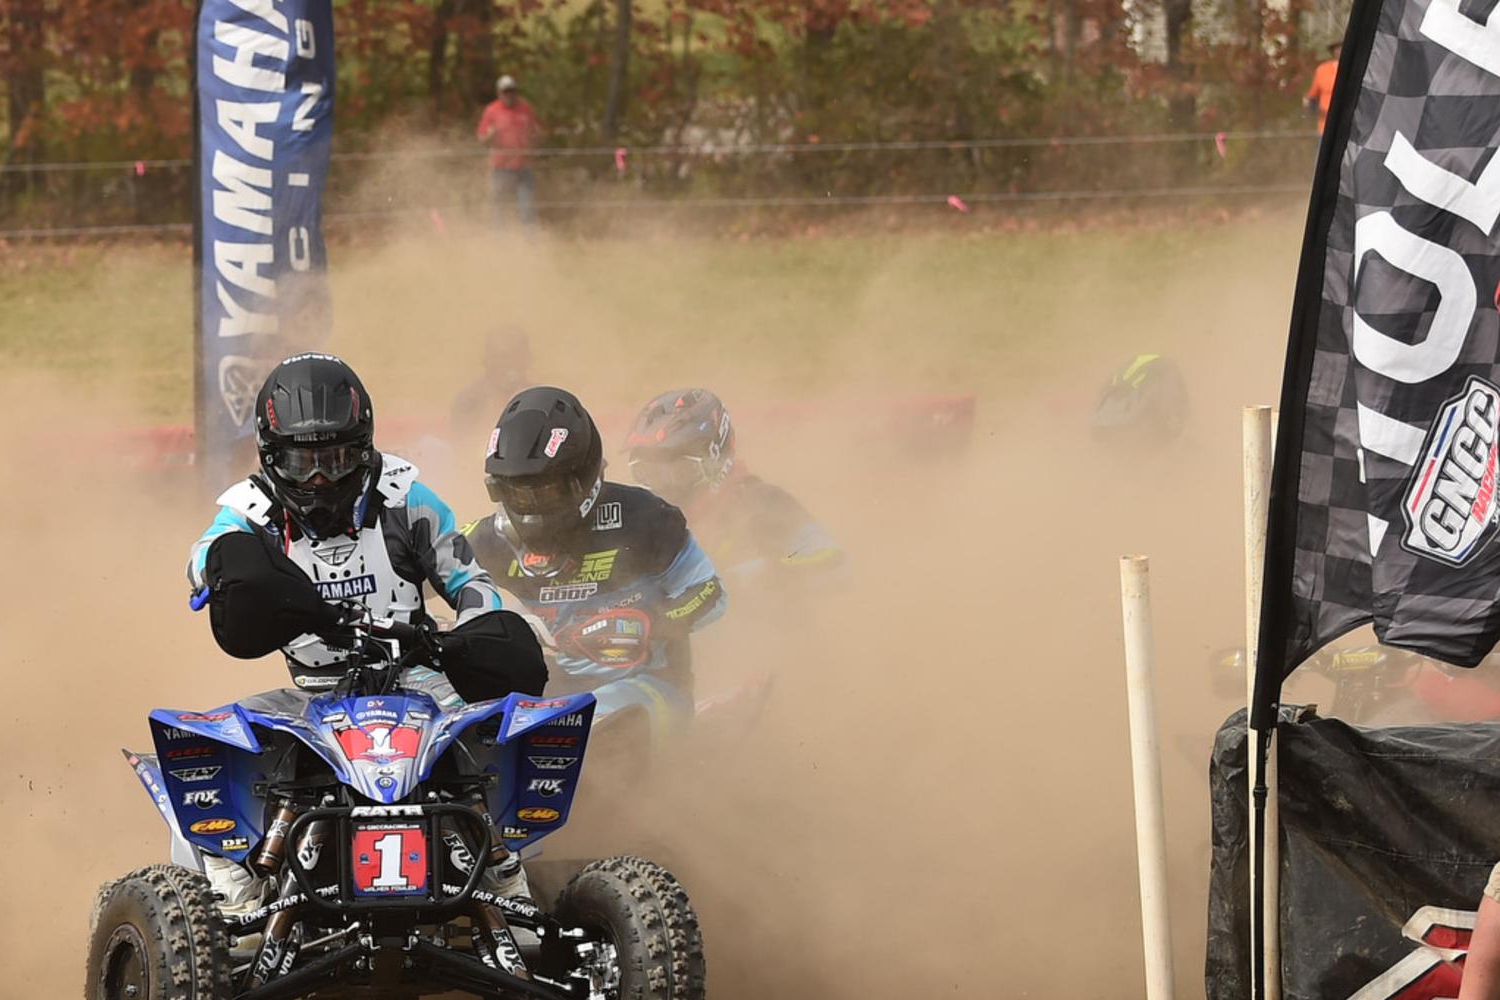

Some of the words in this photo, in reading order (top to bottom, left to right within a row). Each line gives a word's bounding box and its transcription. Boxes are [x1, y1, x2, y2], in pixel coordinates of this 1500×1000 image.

[1420, 388, 1496, 551] GNCC
[317, 577, 373, 599] AMAHA
[366, 727, 402, 754] 1
[182, 788, 222, 810] FOX
[527, 779, 566, 797] FOX
[190, 819, 236, 833] FMF
[373, 833, 408, 887] 1
[240, 904, 268, 925] LONE
[268, 895, 299, 913] STAR
[494, 896, 537, 917] RACING
[253, 932, 286, 984] FOX
[491, 927, 528, 976] FOX
